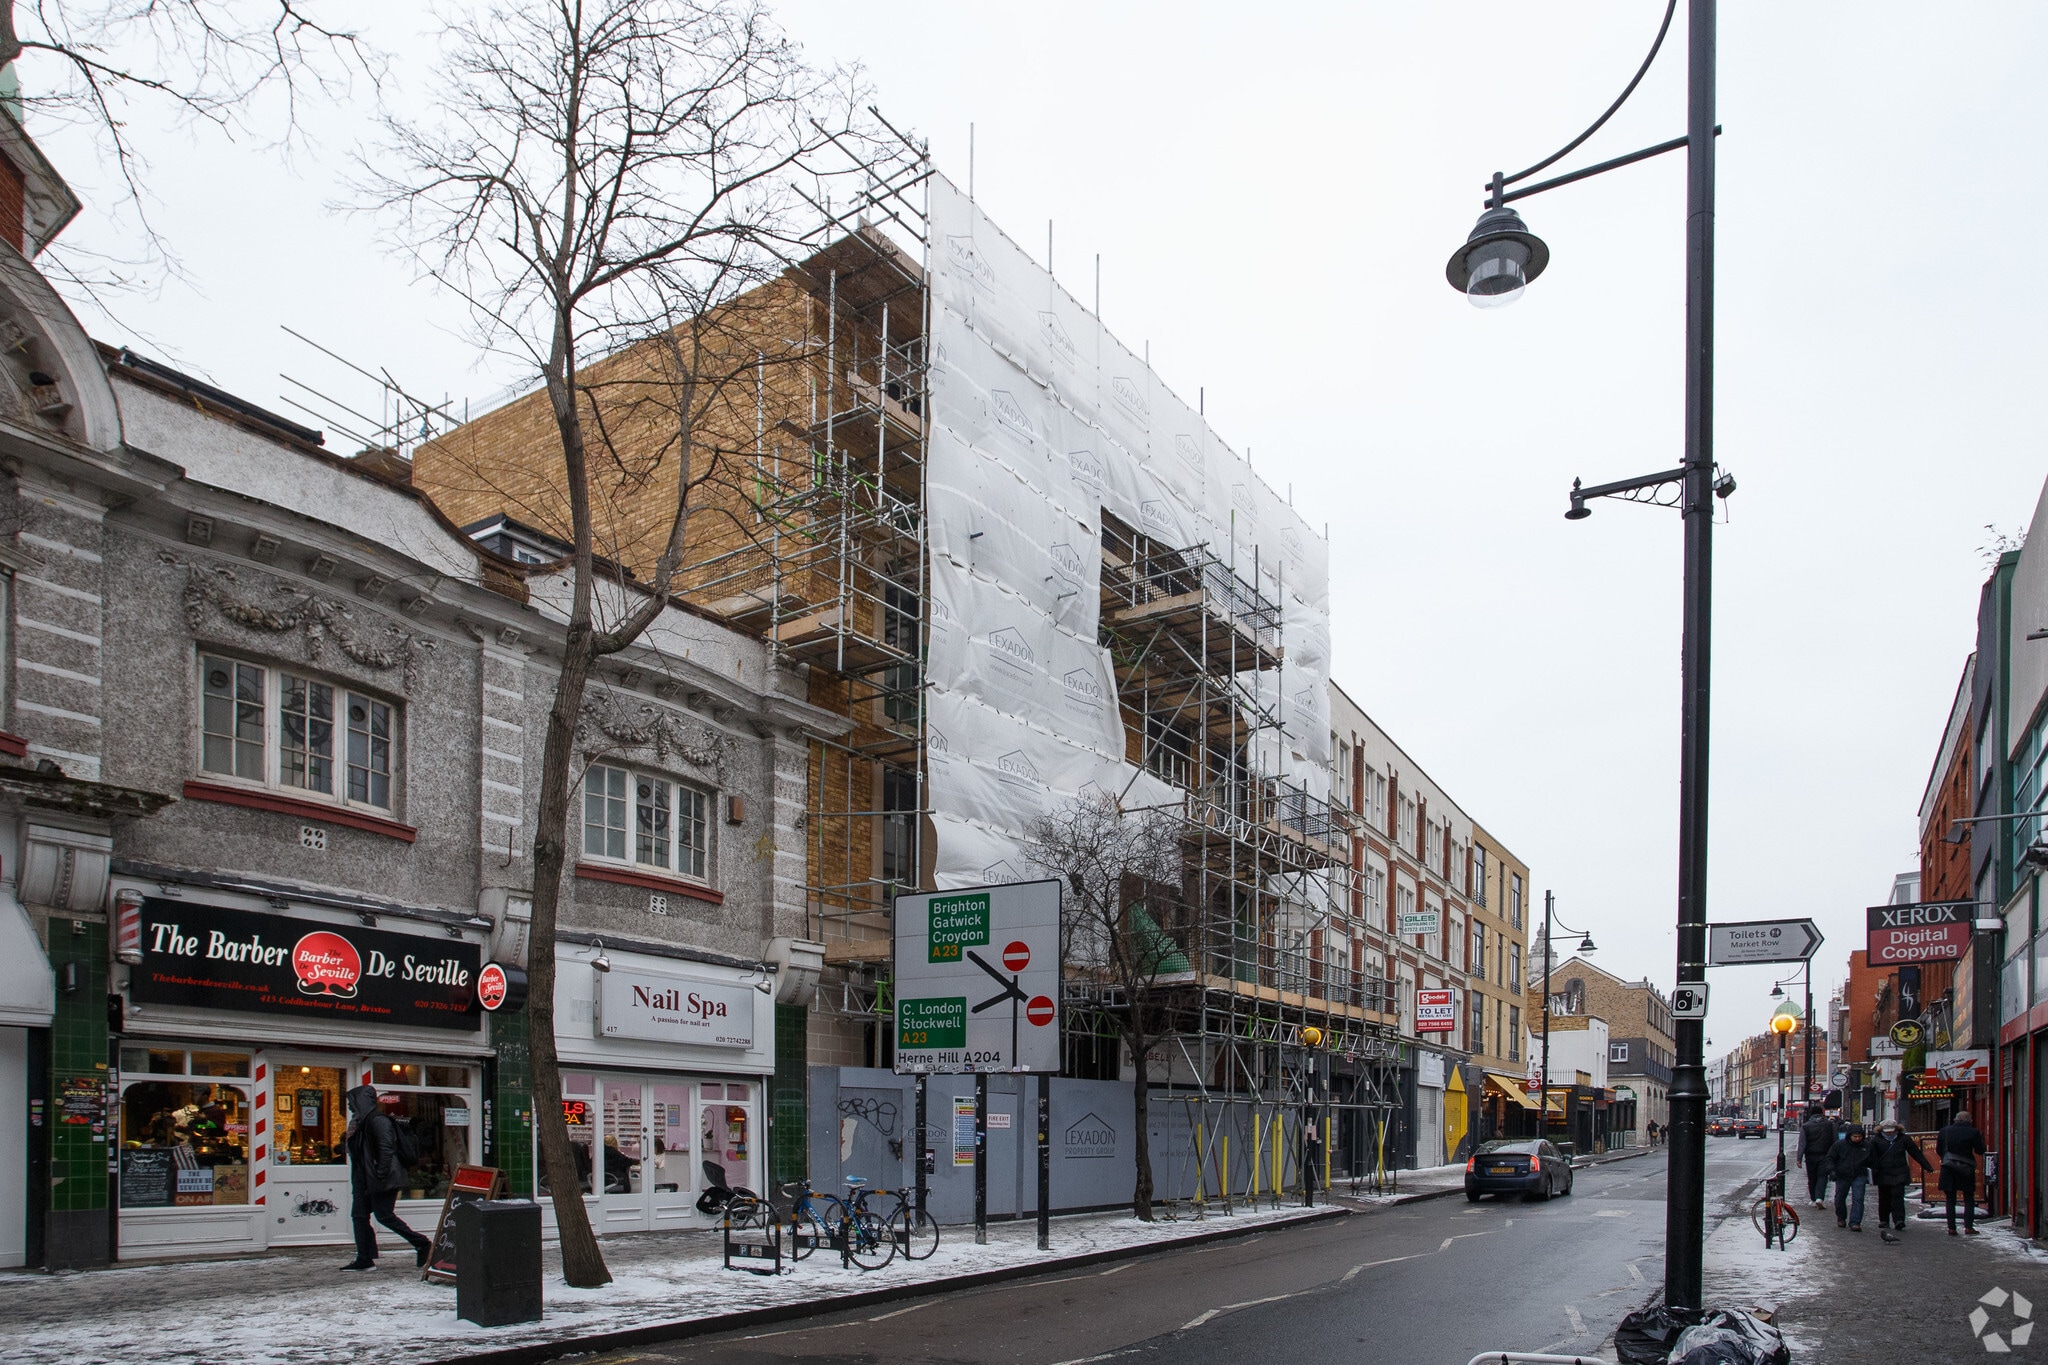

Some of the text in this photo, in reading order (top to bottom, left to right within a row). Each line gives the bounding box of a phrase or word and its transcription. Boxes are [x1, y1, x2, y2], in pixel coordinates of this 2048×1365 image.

[989, 632, 1034, 664] LEXADON
[934, 901, 985, 914] Brighton
[933, 915, 981, 928] Gatwick
[1882, 906, 1957, 927] XEROX
[933, 929, 984, 944] Croydon
[1729, 930, 1766, 939] Toilets
[1891, 928, 1948, 945] Digital
[151, 923, 468, 987] The Barber De Seville
[932, 945, 958, 957] A23
[1882, 944, 1957, 960] Copying
[298, 950, 344, 966] Barber
[307, 964, 355, 980] Seville
[482, 974, 499, 983] Barber
[152, 973, 269, 992] Thebarberdeseville.co.uk
[485, 982, 504, 993] Seville
[259, 995, 391, 1014] 415 Coldharbour Lane, Brixton
[415, 1000, 428, 1008] 020
[632, 985, 727, 1019] Nail Spa
[902, 1003, 962, 1015] C. London
[658, 1017, 678, 1025] passion
[902, 1017, 960, 1029] Stockwell
[727, 1037, 751, 1045] 72742288
[902, 1032, 927, 1043] A23
[898, 1051, 1000, 1063] Herne Hill A204
[1065, 1130, 1115, 1145] LEXADON
[1065, 1147, 1115, 1155] PROPERTY GROUP
[176, 1195, 213, 1203] ON AIR
